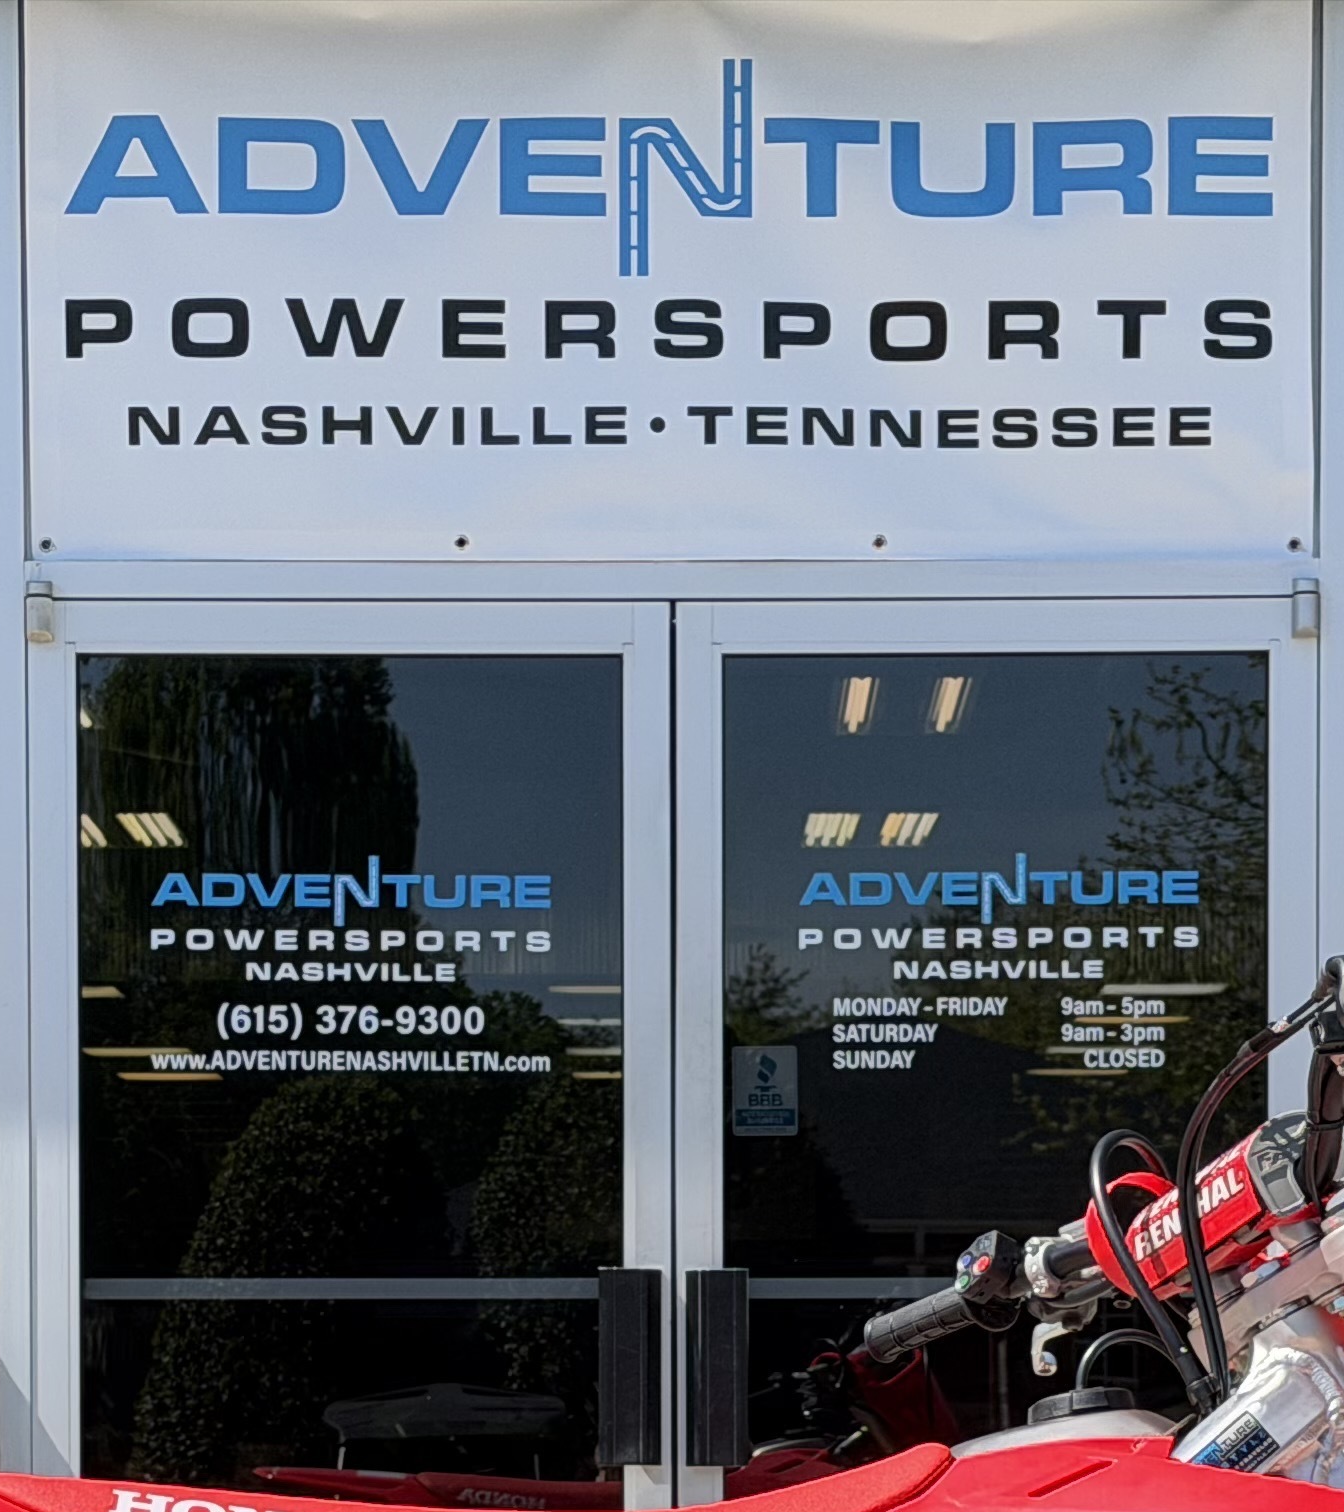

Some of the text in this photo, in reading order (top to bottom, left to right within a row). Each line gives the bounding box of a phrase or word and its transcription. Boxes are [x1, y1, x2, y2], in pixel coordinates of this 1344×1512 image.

[64, 58, 1274, 278] ADVENTURE
[64, 296, 1275, 363] POWERSPORTS
[150, 855, 553, 928] ADVENTURE
[799, 852, 1201, 925] ADVENTURE
[150, 928, 552, 952] POWERSPORTS
[798, 926, 1200, 951] POWERSPORTS
[244, 961, 457, 983] NASHVILLE
[892, 958, 1105, 981] NASHVILLE
[216, 1002, 485, 1041] (615) 376-9300
[832, 1023, 938, 1043] SATURDAY
[149, 1048, 552, 1072] www.ADVENTURENASHVILLETN.com
[832, 1049, 1166, 1069] SUNDAY CLOSED
[748, 1093, 784, 1107] BBB
[1132, 1166, 1246, 1263] RENHAL
